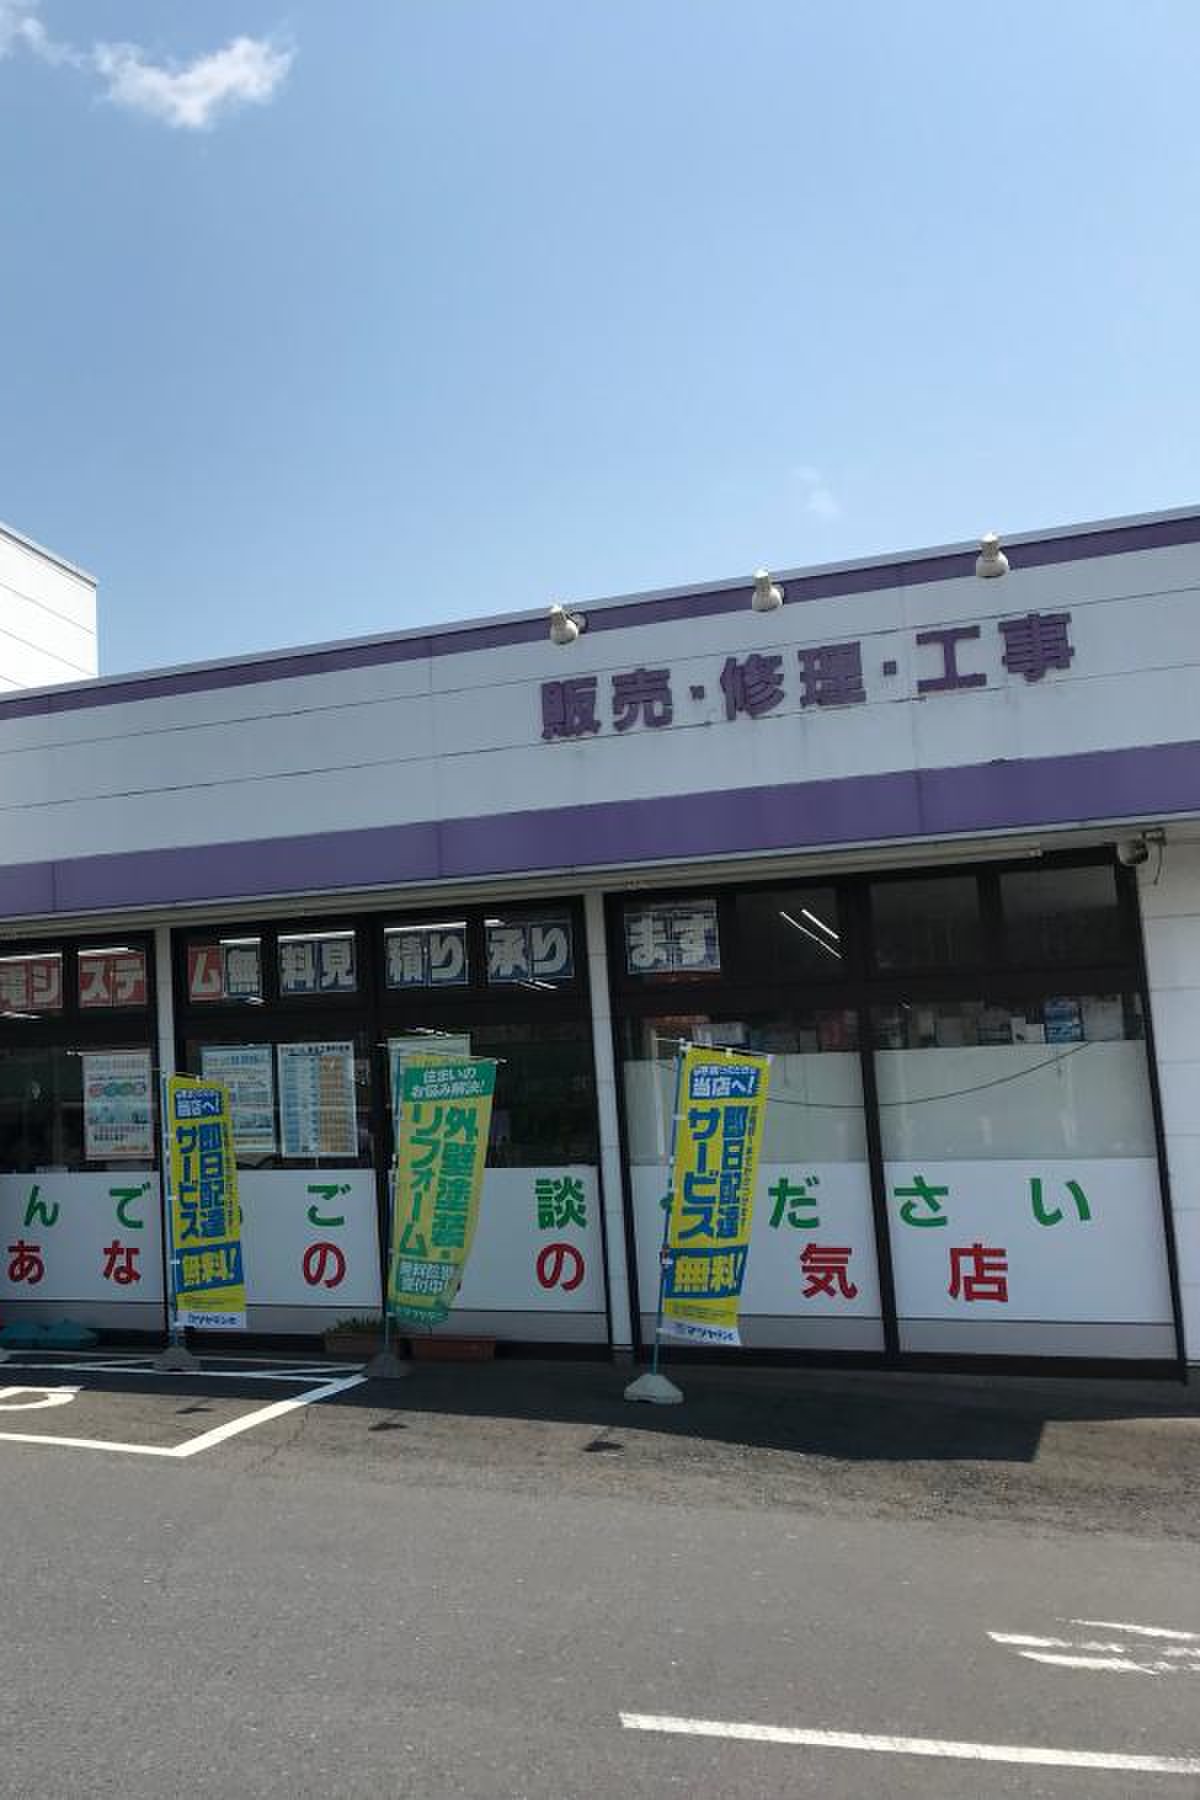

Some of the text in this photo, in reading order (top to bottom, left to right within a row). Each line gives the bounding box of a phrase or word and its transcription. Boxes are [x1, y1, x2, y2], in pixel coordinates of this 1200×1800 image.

[541, 612, 1076, 741] 販売・修理・工事
[175, 1126, 200, 1240] サービス
[399, 1104, 443, 1257] リフォーム
[678, 1106, 721, 1240] サービス
